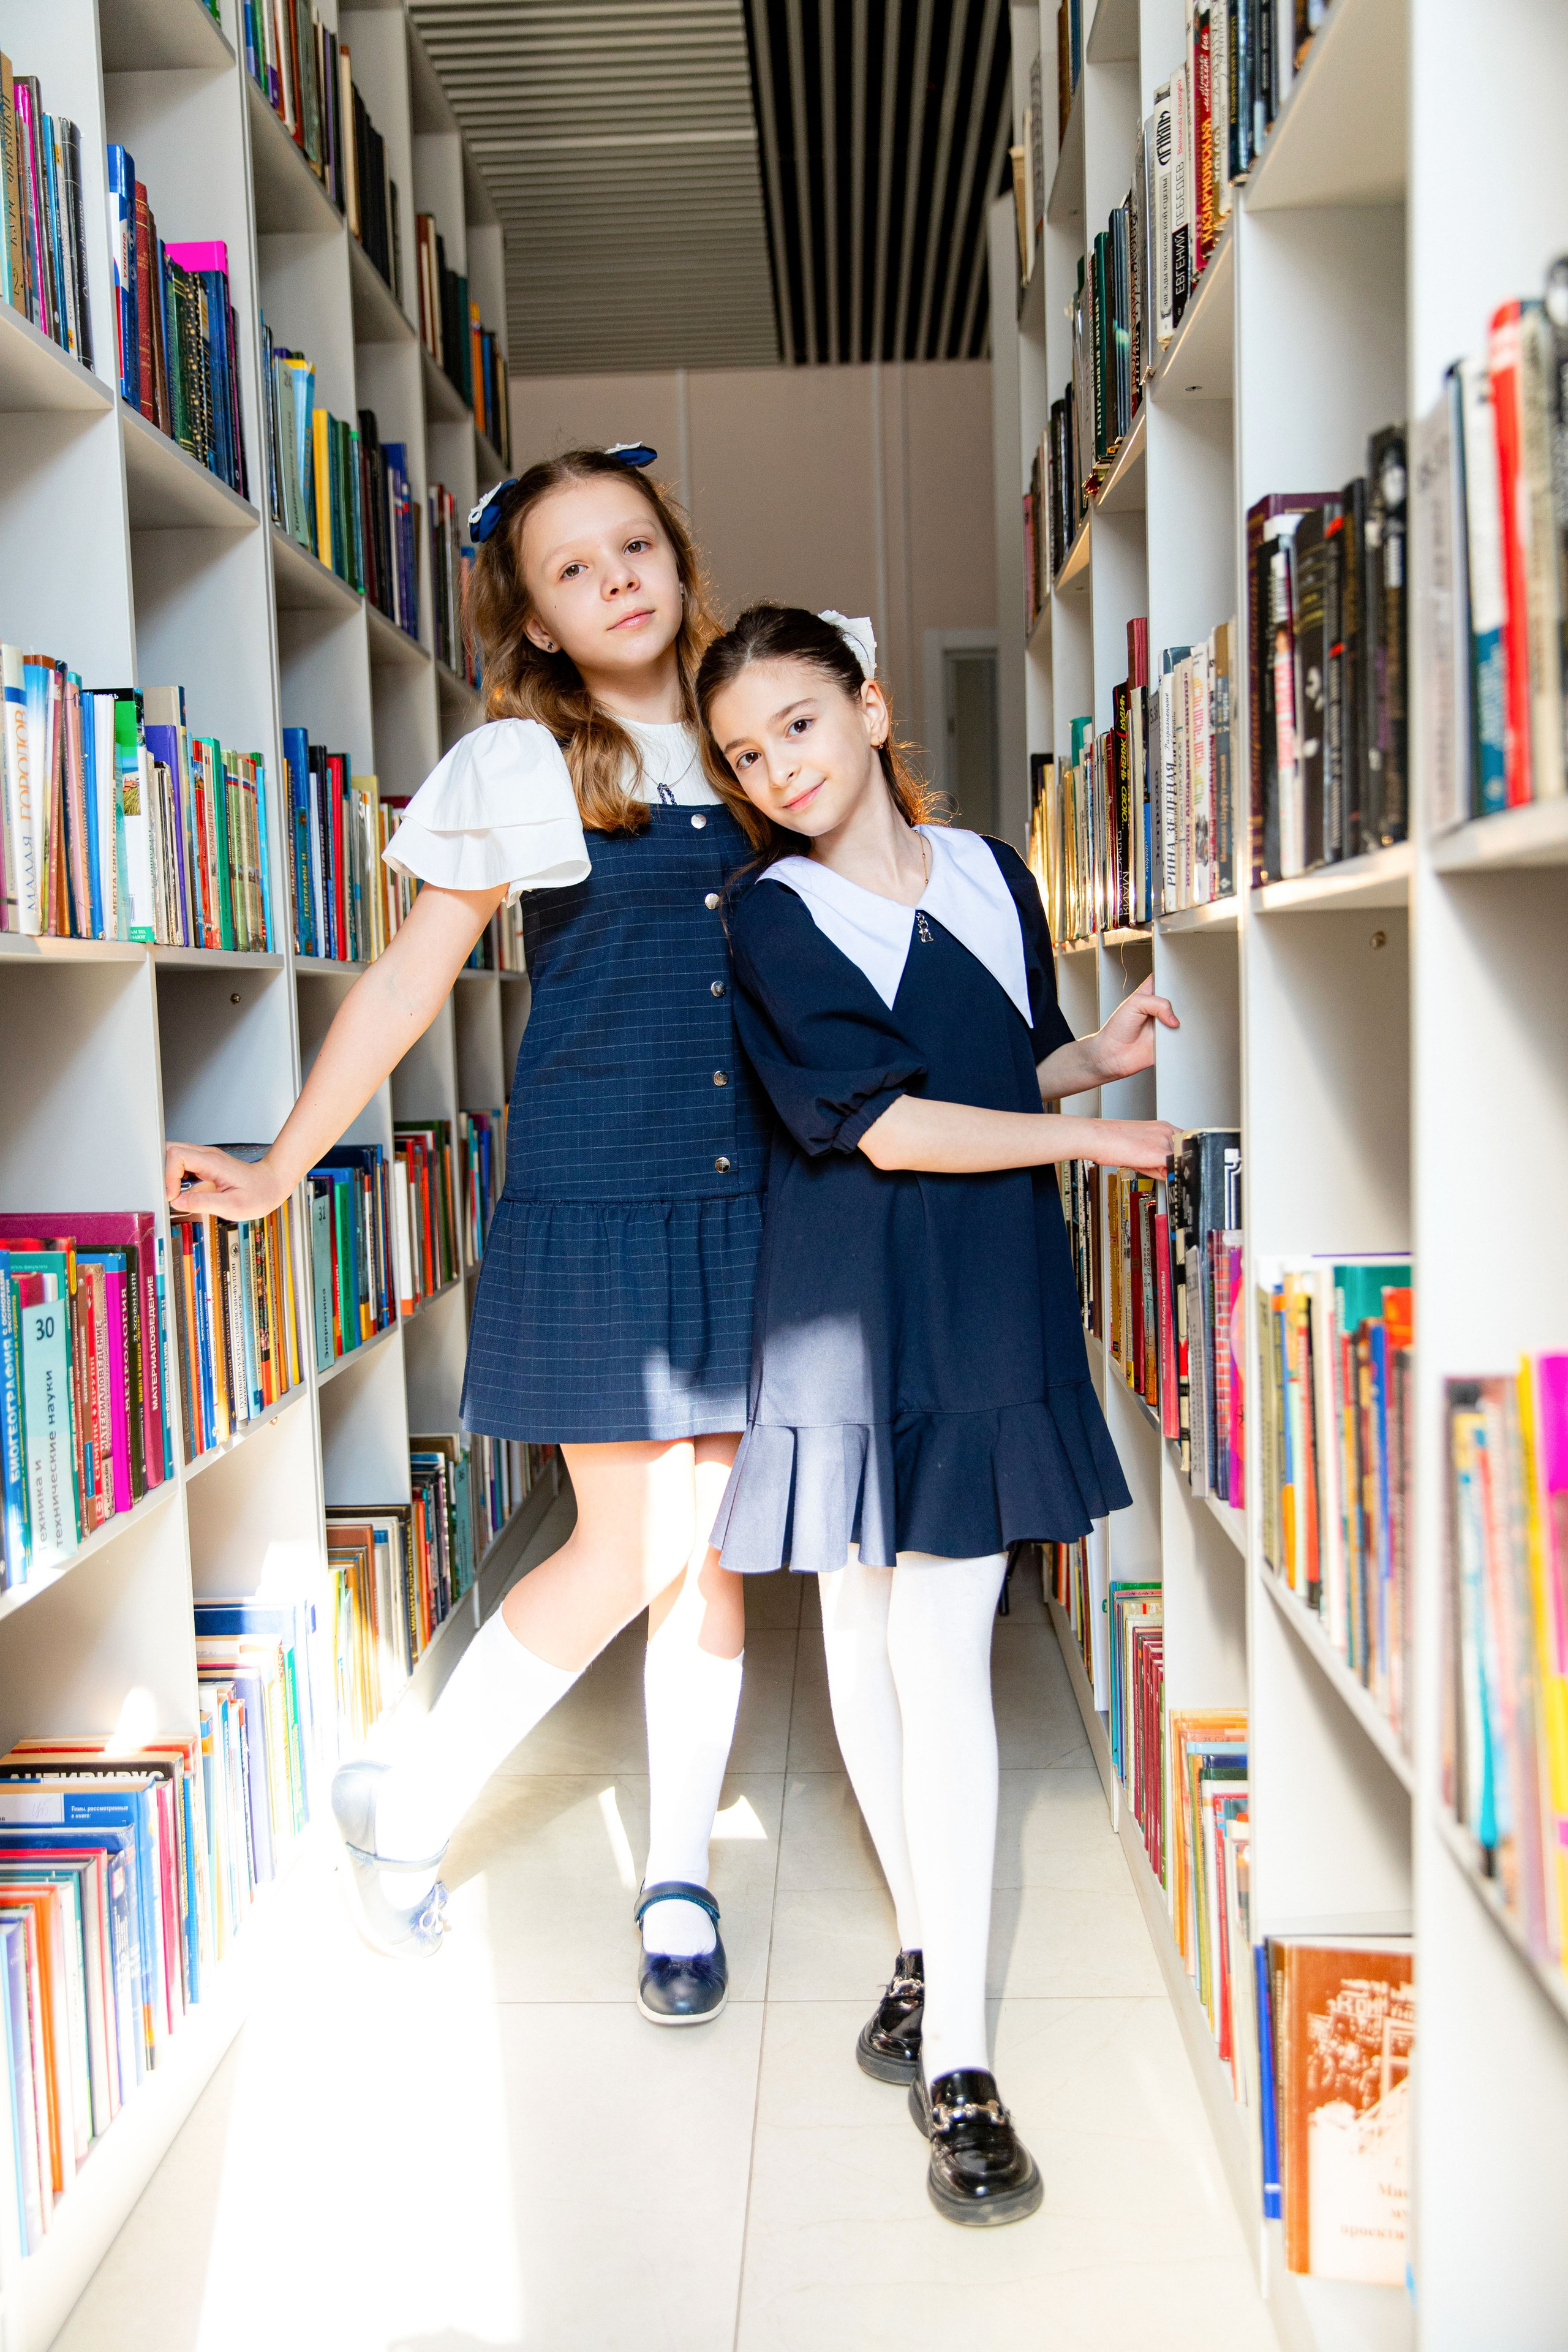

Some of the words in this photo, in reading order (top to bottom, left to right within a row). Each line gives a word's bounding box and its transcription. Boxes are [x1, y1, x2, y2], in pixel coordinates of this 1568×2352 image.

[1176, 79, 1185, 115] лицедей
[1176, 161, 1185, 226] ЛЕБЕДЕВ
[1201, 118, 1212, 244] КАЗАРНОВСКАЯ
[1174, 230, 1186, 294] ЕВГЕНИЙ
[23, 836, 36, 911] МАЛАЯ
[1166, 842, 1176, 886] РИНА
[319, 1205, 326, 1221] 31
[245, 1248, 254, 1336] ПОТРЕБИТЕЛЬСКИХ
[36, 1315, 55, 1341] 30
[148, 1275, 158, 1410] МАТЕРИАЛОВЕДЕНИЕ
[3, 1339, 21, 1483] БИОГЕОГРАФИЯ
[45, 1370, 56, 1425] науки
[96, 1322, 108, 1451] МАТЕРИАЛОВЕДЕНИЕ
[34, 1460, 41, 1471] и
[48, 1431, 64, 1548] технические
